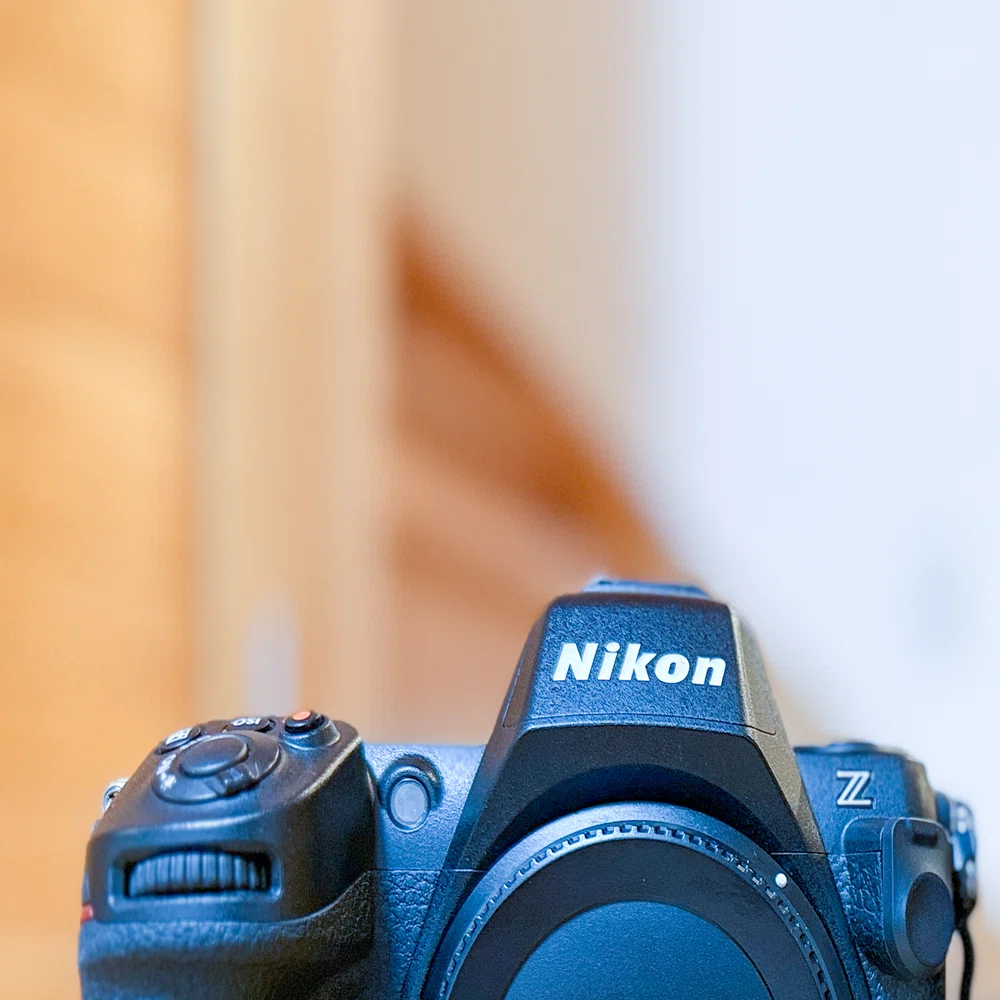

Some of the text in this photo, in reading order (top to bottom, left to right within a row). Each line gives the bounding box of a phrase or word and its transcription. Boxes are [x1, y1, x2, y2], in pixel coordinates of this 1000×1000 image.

[552, 641, 726, 687] Nikon
[231, 717, 261, 727] ISO
[836, 770, 871, 805] Z
